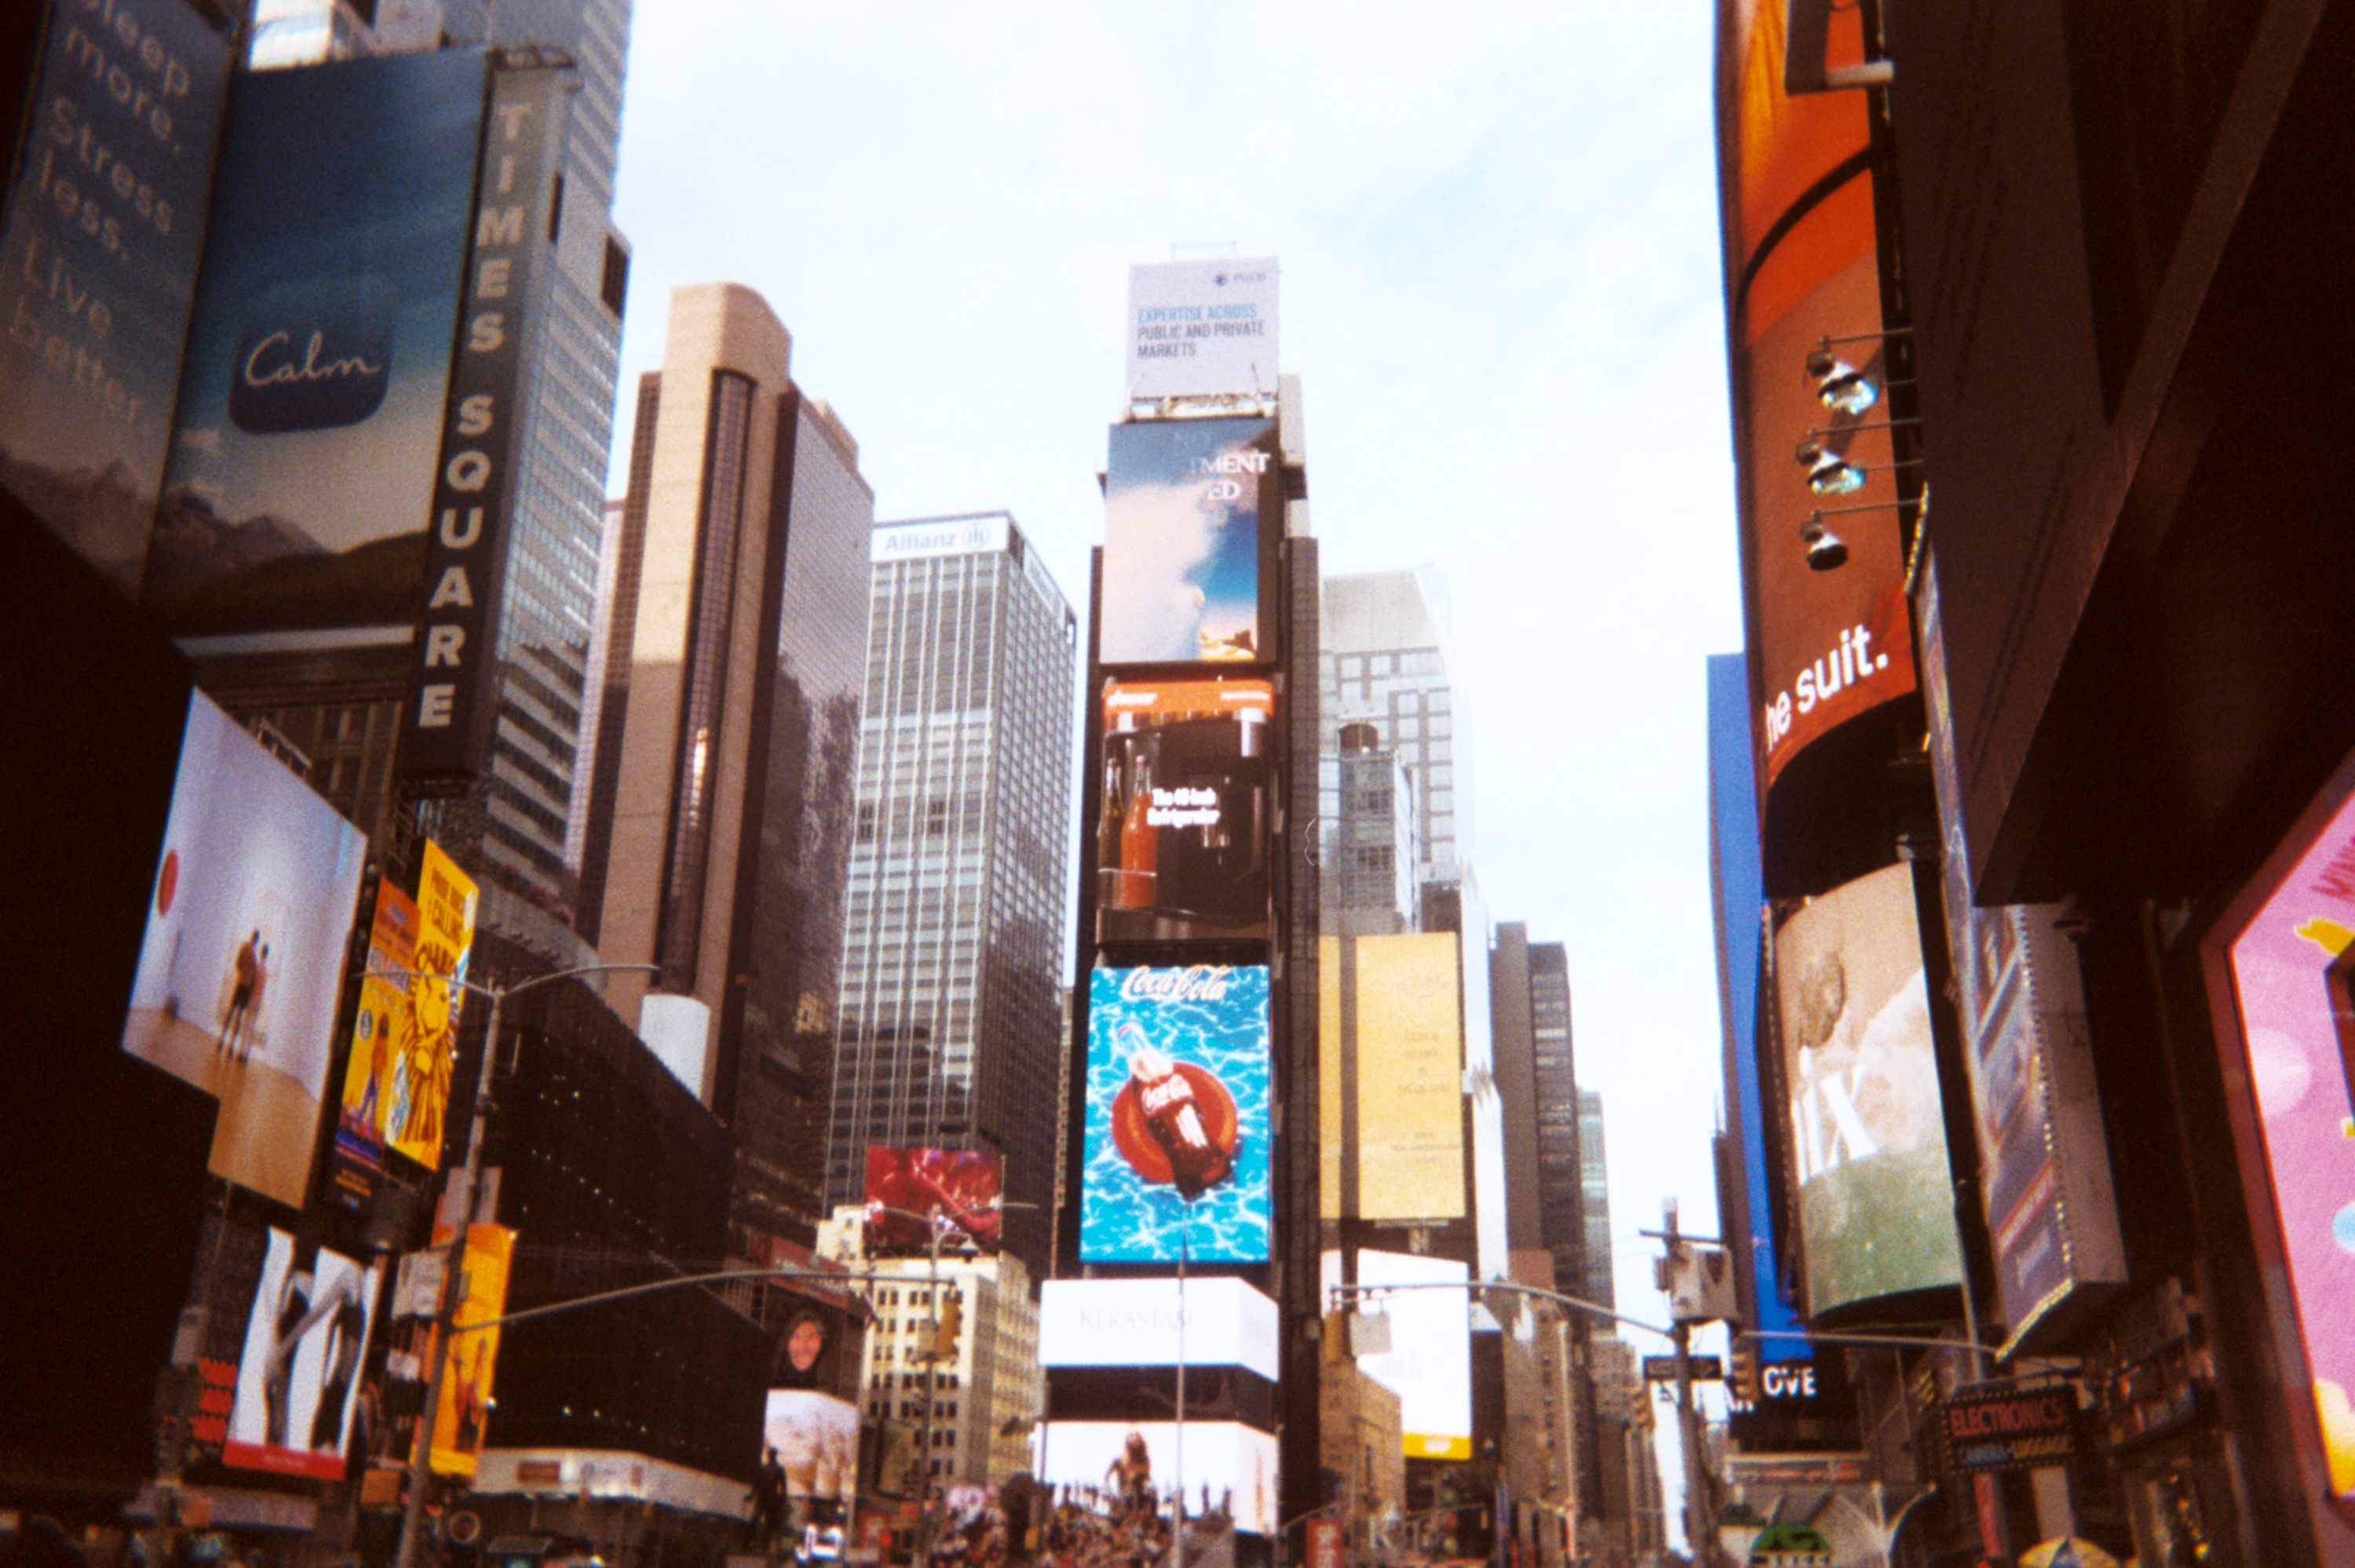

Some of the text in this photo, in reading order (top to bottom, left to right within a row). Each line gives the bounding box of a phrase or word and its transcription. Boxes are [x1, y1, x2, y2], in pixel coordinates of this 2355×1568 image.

[82, 0, 190, 97] leep
[49, 97, 173, 235] Stress
[1137, 320, 1265, 341] PUBLIC AND PRIVATE
[1138, 304, 1258, 324] EXPERTISE ACROSS
[244, 330, 382, 388] Calm
[1137, 342, 1196, 358] MARKETS
[418, 104, 531, 728] TIMES SQUARE
[885, 532, 958, 552] Allianz
[1795, 623, 1888, 714] suit.
[1121, 964, 1232, 1001] Coca-Cola
[1949, 1396, 2065, 1438] ELECTRONICS
